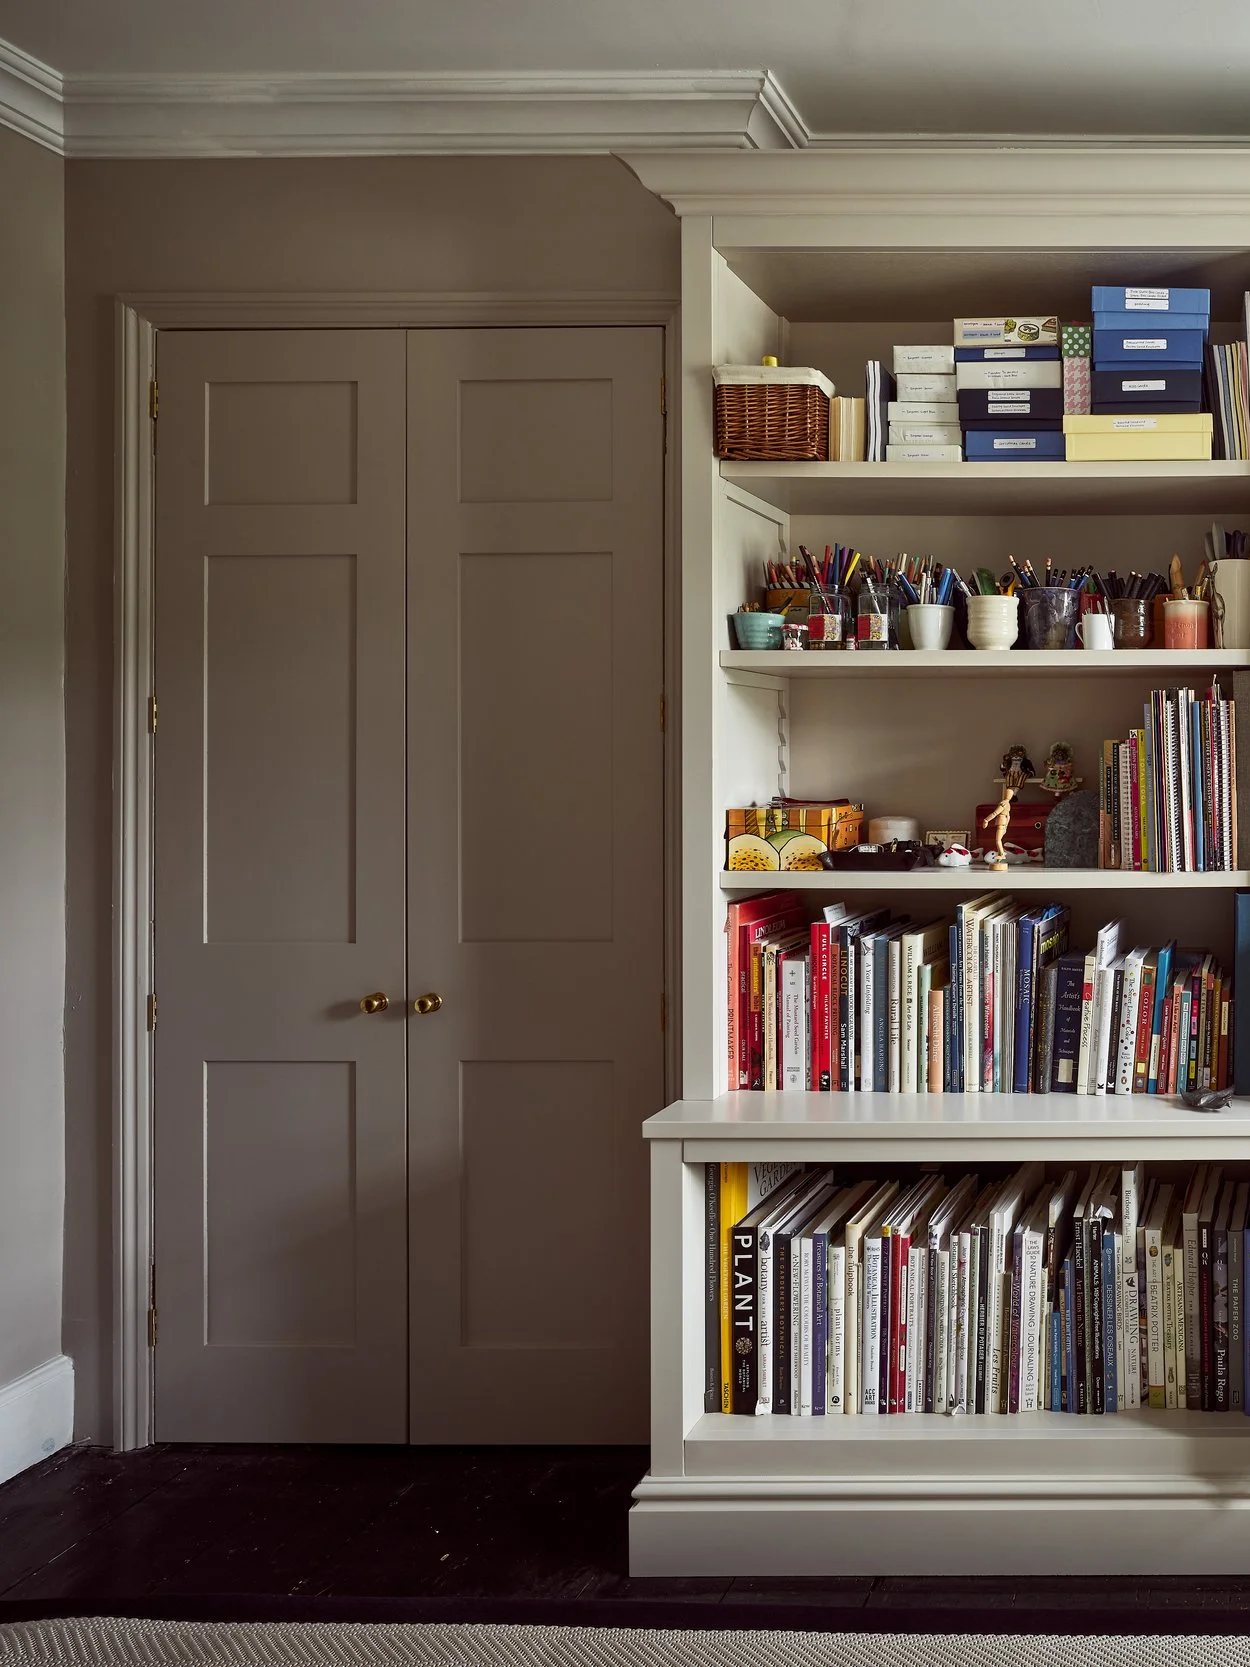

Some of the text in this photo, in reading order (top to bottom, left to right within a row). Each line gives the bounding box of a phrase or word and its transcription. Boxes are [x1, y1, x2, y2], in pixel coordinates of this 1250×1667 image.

[966, 918, 974, 1005] WATERCOLOR ARTIST
[1058, 1004, 1081, 1012] Handbook
[1061, 992, 1080, 1000] Artist's
[890, 998, 899, 1045] Rural Life
[932, 1004, 940, 1038] Albrecht
[1082, 1023, 1090, 1048] Process
[708, 1164, 716, 1190] Georgia
[1124, 1190, 1132, 1220] Birdsong
[816, 1241, 824, 1272] Treasures
[1186, 1240, 1196, 1296] Edward Hopper
[734, 1235, 753, 1331] PLANT
[758, 1256, 770, 1292] botany
[846, 1261, 855, 1296] Tulpbook
[816, 1283, 824, 1313] Botanical
[871, 1254, 879, 1339] BOTANICAL ILLUSTRATION
[816, 1314, 824, 1325] Art
[834, 1308, 842, 1330] plant
[978, 1328, 984, 1336] DU
[1027, 1261, 1037, 1381] NATURE DRAWING JOURNALING
[1129, 1290, 1138, 1344] DRAWING
[760, 1320, 770, 1347] artist
[1151, 1321, 1159, 1352] POTTER
[992, 1367, 1000, 1394] Fruits
[1215, 1350, 1225, 1402] Paula Rego
